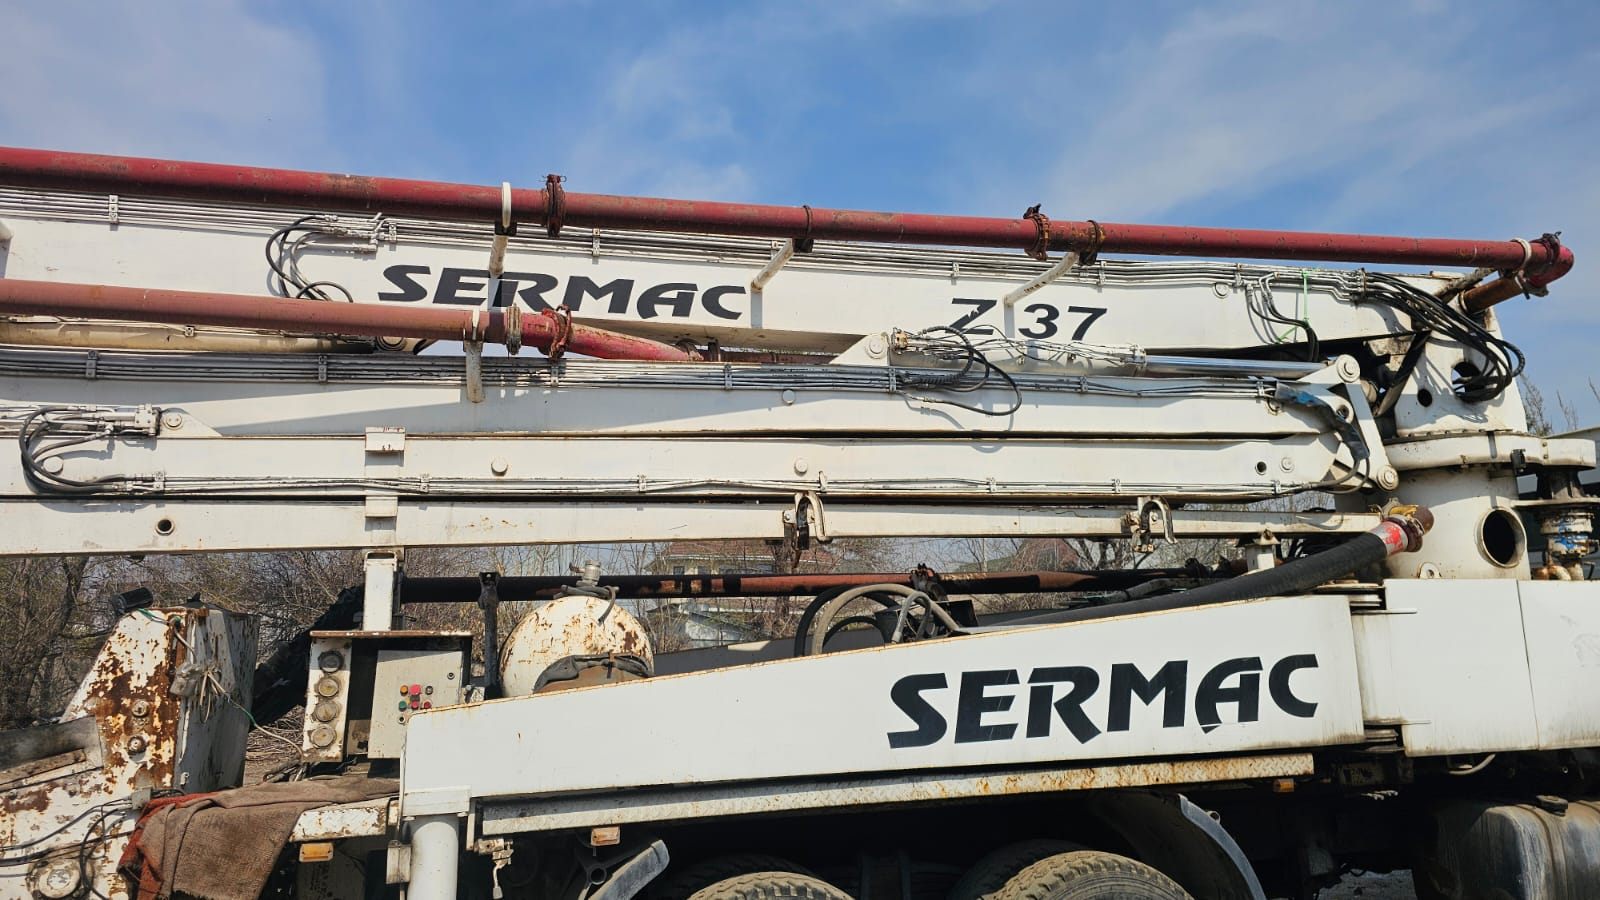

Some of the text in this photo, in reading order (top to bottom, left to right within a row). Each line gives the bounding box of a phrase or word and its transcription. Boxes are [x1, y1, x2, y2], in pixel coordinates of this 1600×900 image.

[377, 264, 747, 320] SERMAC
[945, 298, 1108, 341] Z 37
[887, 653, 1319, 749] SERMAC
